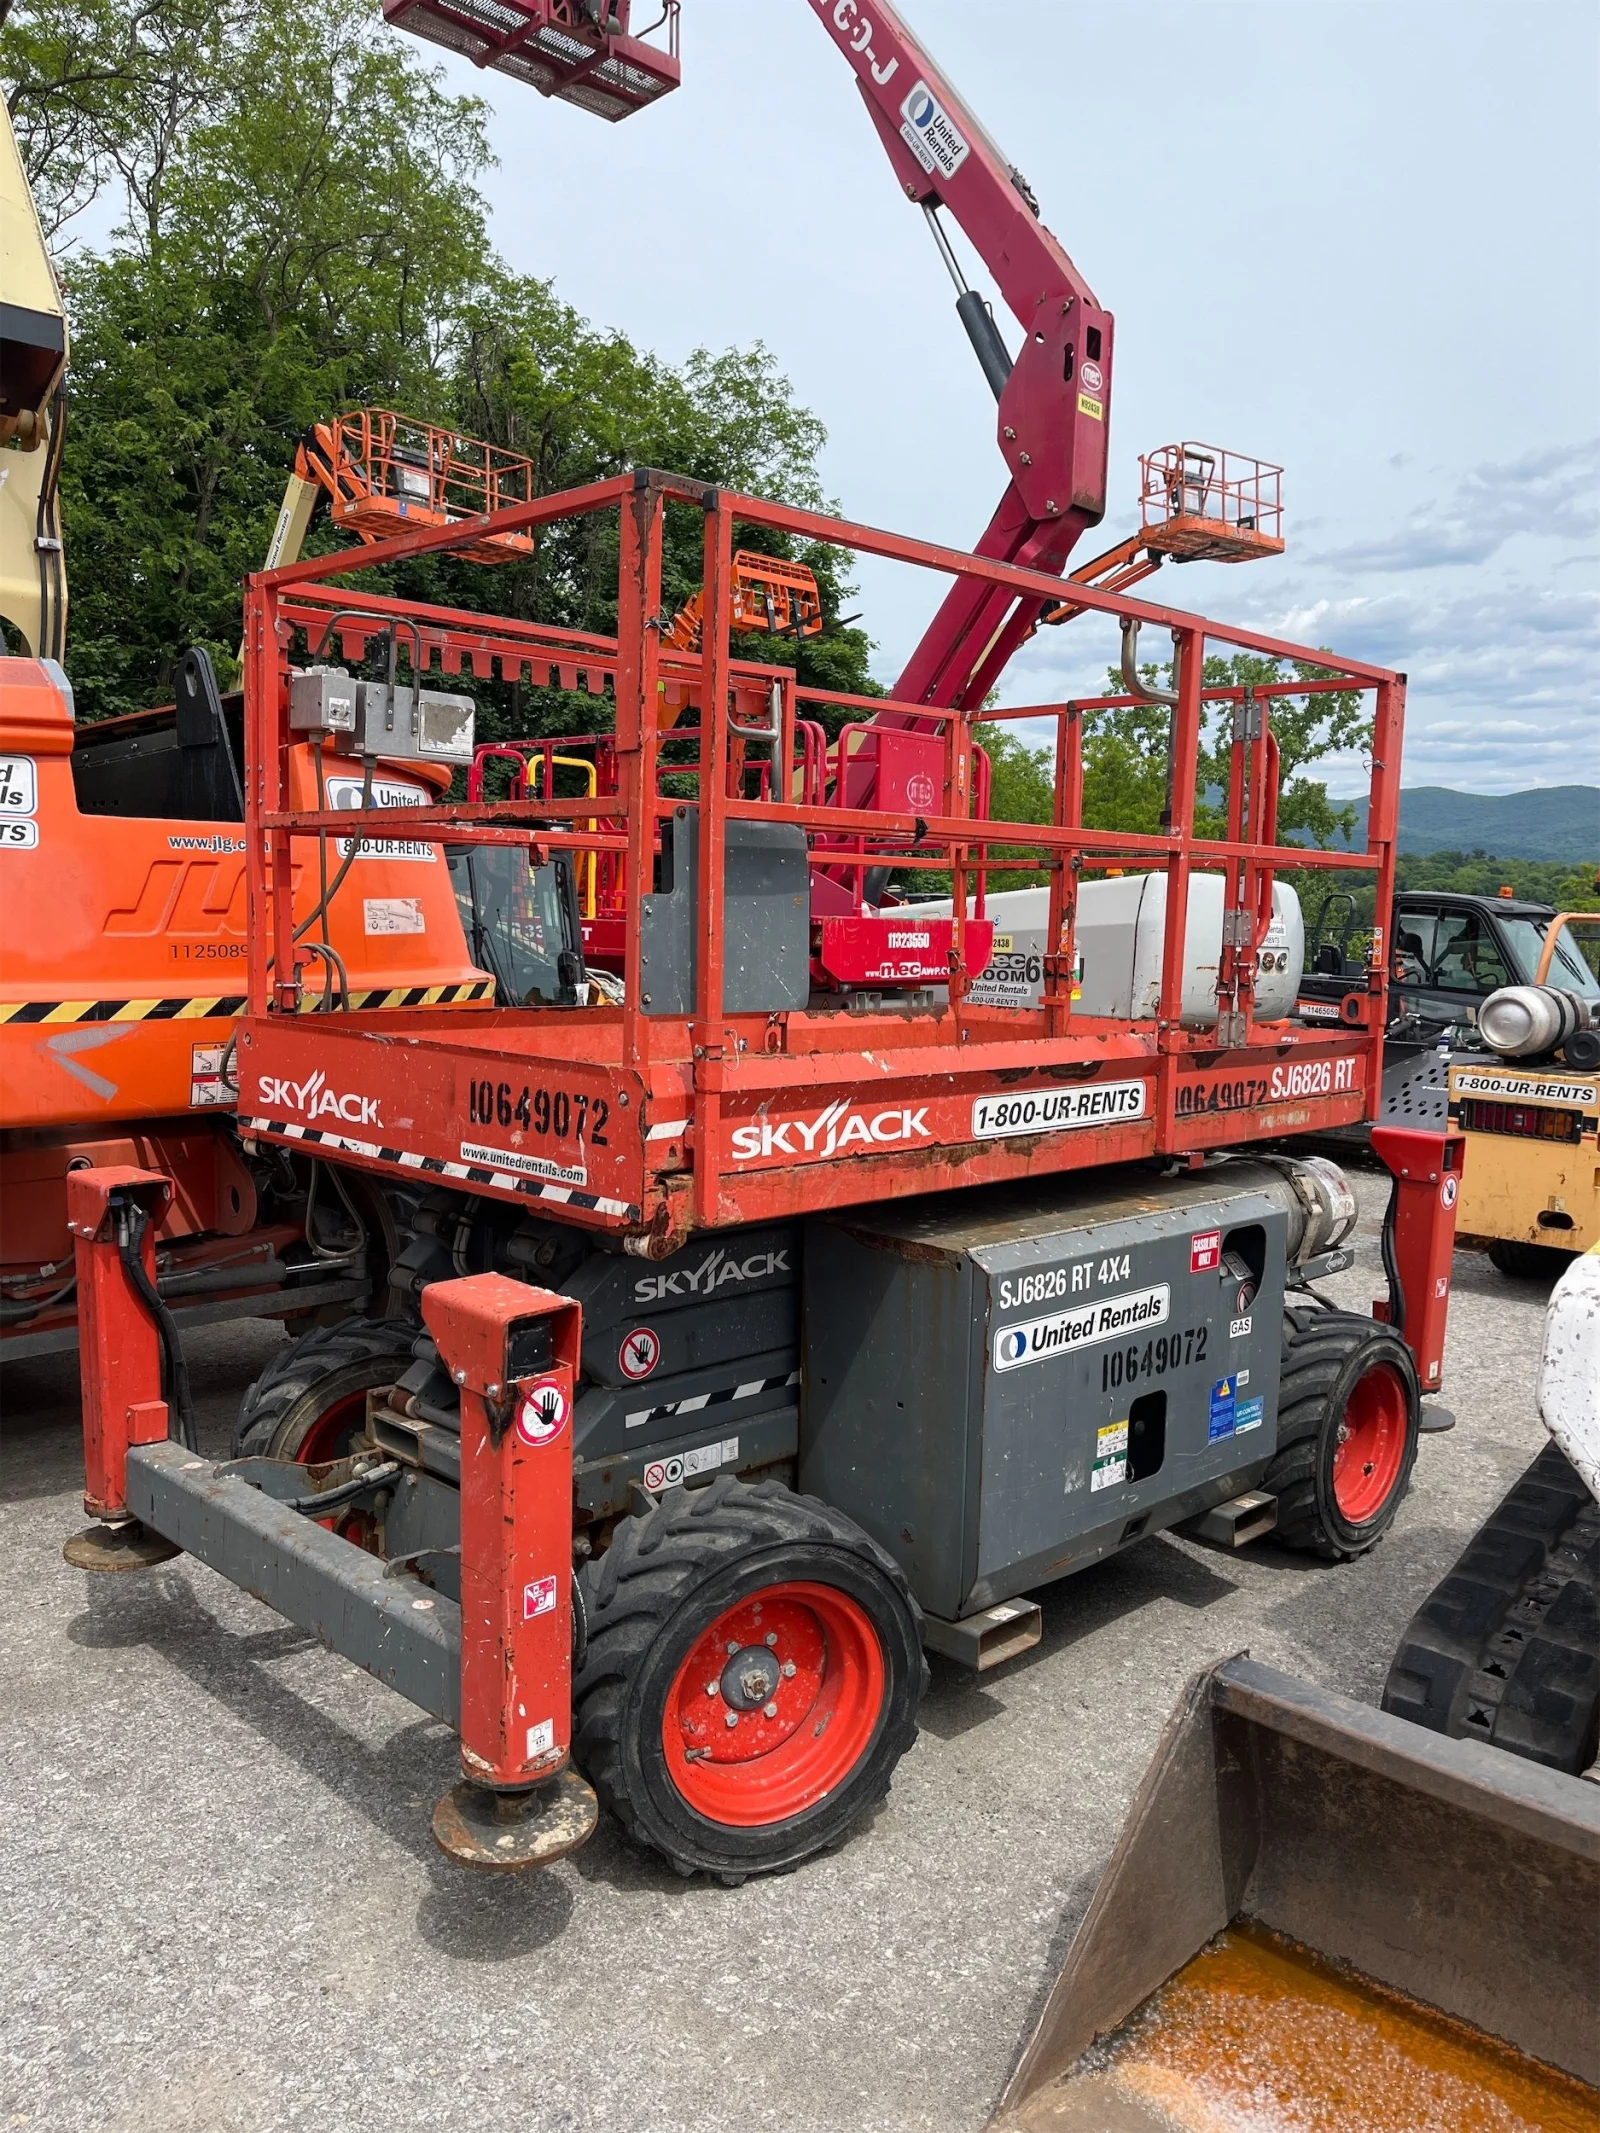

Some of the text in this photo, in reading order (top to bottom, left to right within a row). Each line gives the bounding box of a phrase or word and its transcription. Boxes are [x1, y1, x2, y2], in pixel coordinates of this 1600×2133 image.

[902, 126, 932, 170] 1-800-UR-RENTS
[923, 126, 955, 172] Rentals
[933, 115, 963, 156] United
[276, 513, 289, 545] Rentals
[380, 789, 419, 807] United
[168, 836, 270, 852] www.jlg.c
[888, 932, 929, 949] 11323550
[992, 939, 1010, 948] 2438
[971, 982, 1029, 995] United Rentals
[979, 968, 1025, 983] OOM
[966, 995, 1018, 1006] 1-800-UR-RENTS
[1270, 1058, 1356, 1099] SJ6826 RT
[1457, 1077, 1594, 1101] 1-800-UR-RENTS
[258, 1069, 385, 1128] SKYJACK
[470, 1078, 609, 1147] 10649072
[978, 1087, 1141, 1130] 1-800-UR-RENTS
[731, 1097, 931, 1159] SKYJACK
[462, 1147, 584, 1182] www.unitedrentals.com
[1193, 1236, 1219, 1253] GASOLINE
[634, 1249, 792, 1303] SKYJACK
[999, 1254, 1131, 1310] SJ6826 RT 4X4
[1032, 1296, 1161, 1351] United Rentals
[1231, 1319, 1250, 1334] GAS
[1102, 1326, 1208, 1392] 10649072
